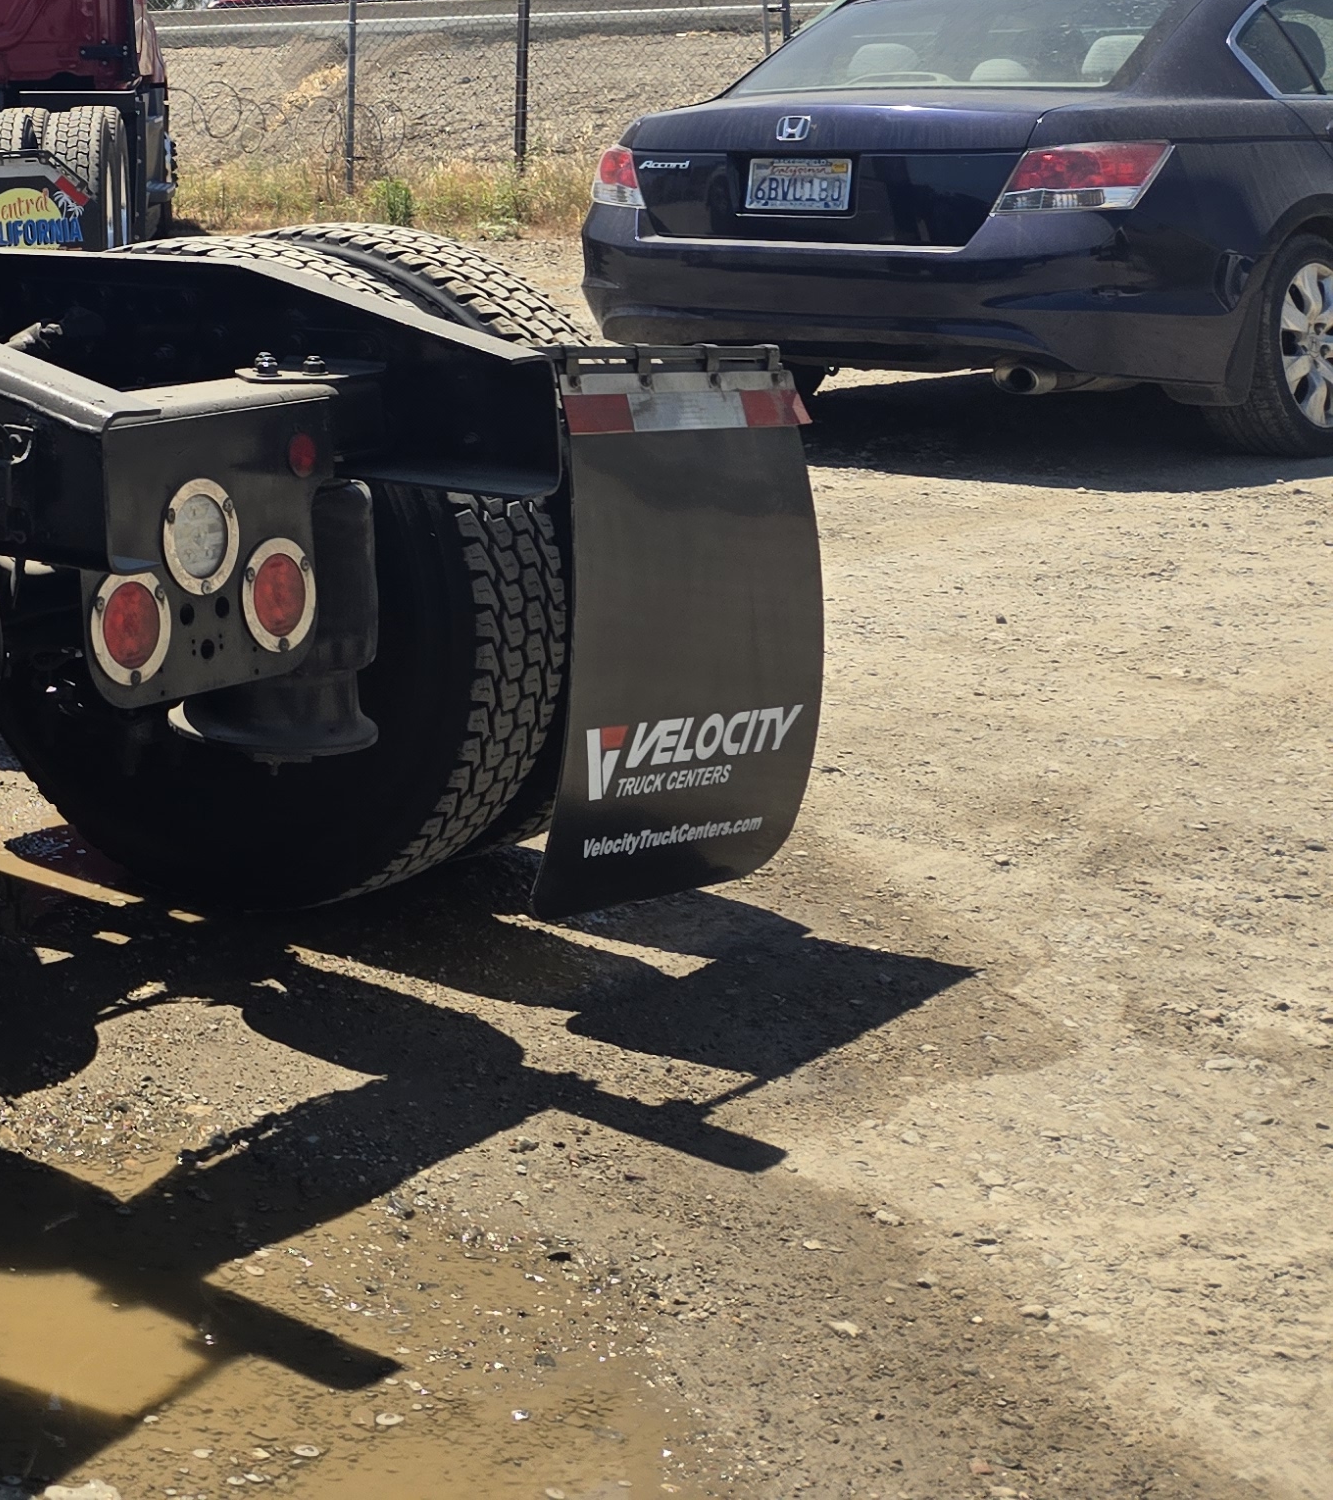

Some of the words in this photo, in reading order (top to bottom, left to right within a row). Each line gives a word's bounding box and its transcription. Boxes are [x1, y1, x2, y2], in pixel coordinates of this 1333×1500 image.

[638, 160, 691, 170] Accord
[624, 703, 804, 770] VELOCITY
[615, 772, 666, 798] TRUCK
[665, 764, 732, 791] CENTERS
[582, 816, 763, 859] VelocityTruckCenters.com
